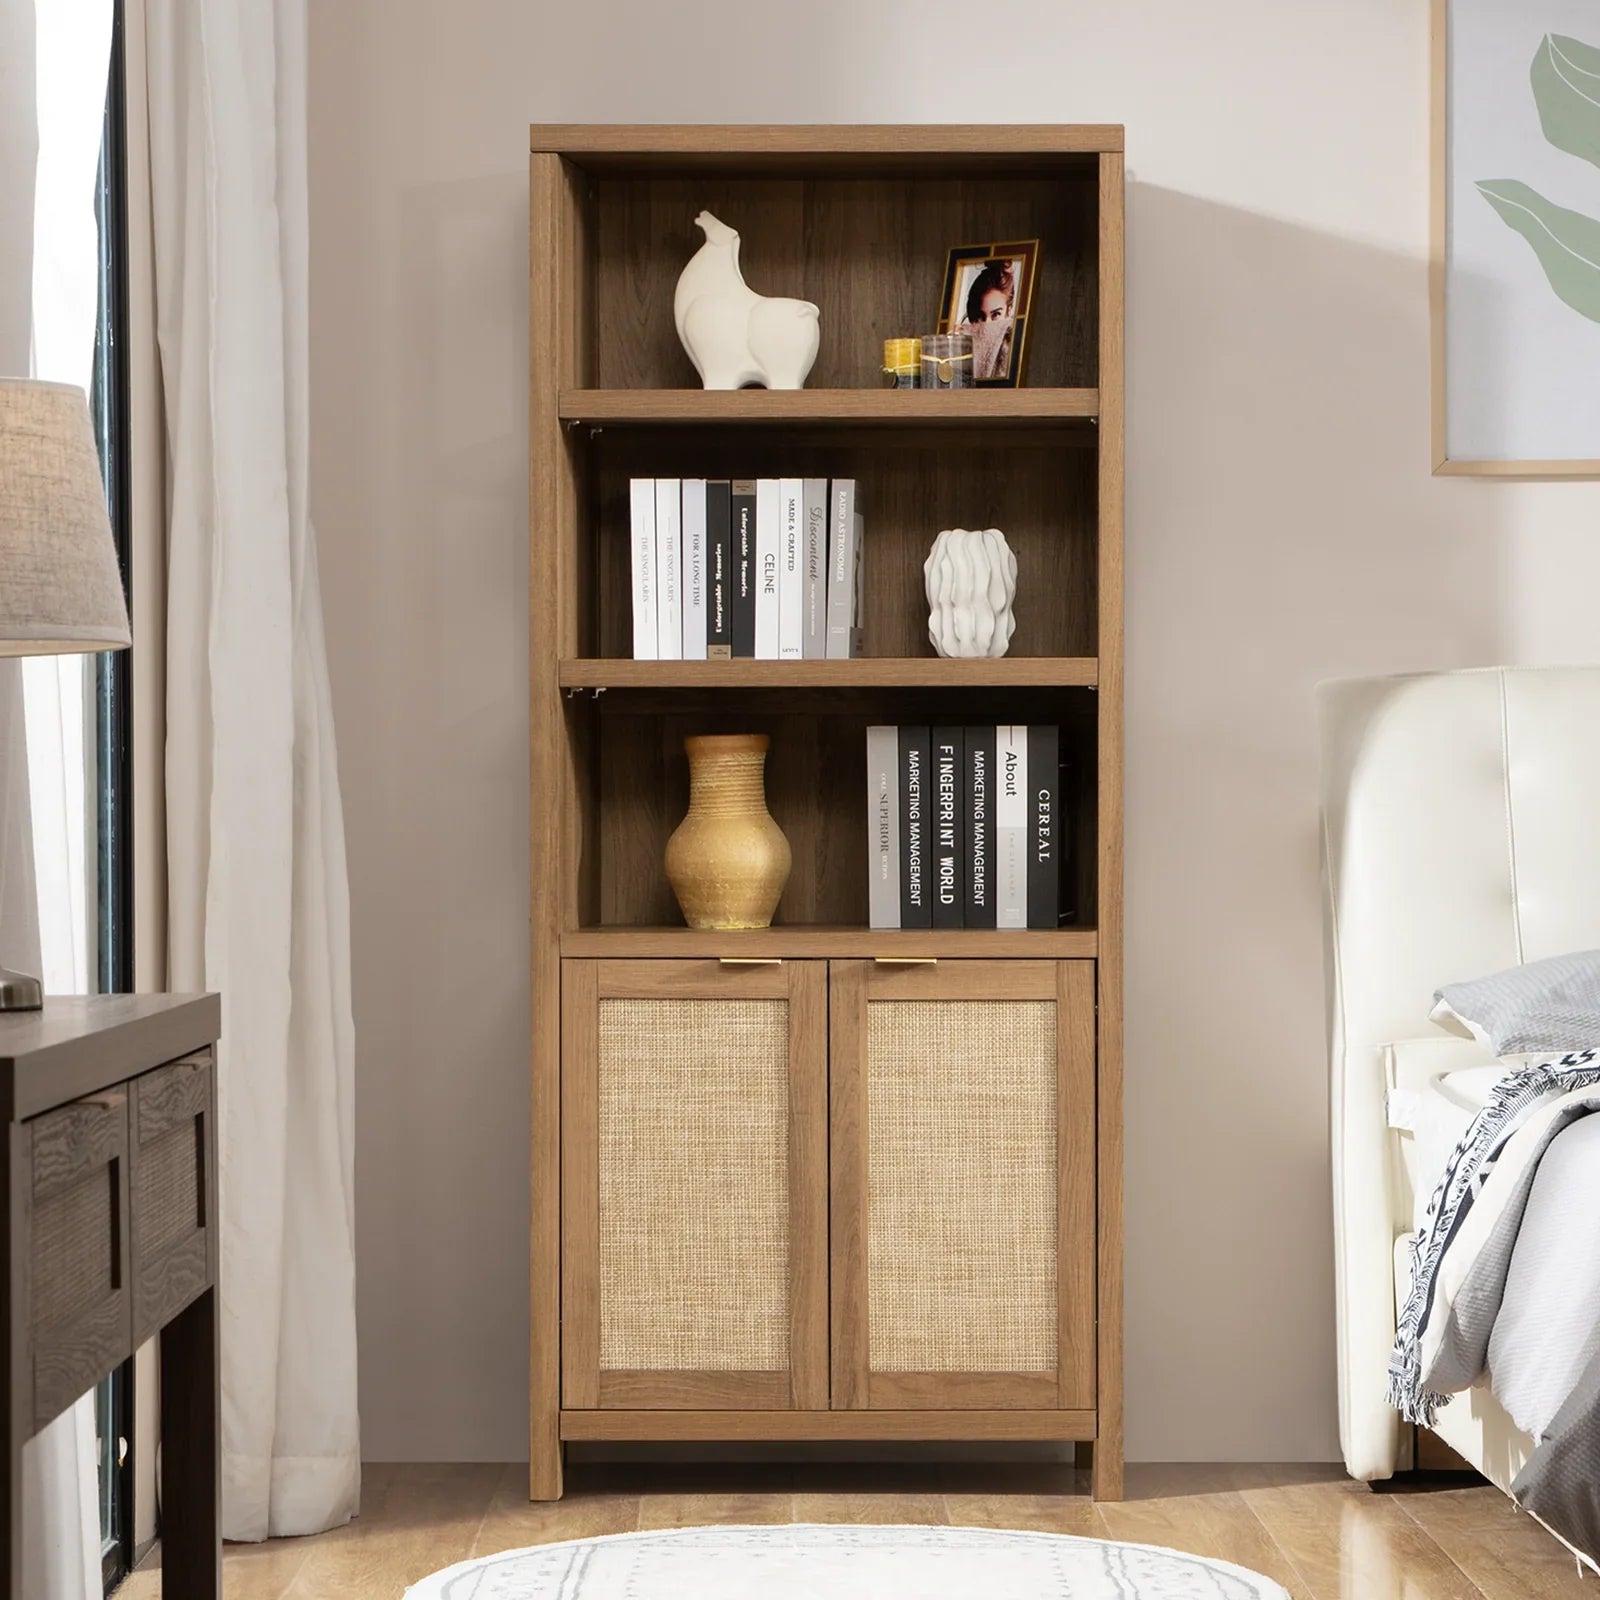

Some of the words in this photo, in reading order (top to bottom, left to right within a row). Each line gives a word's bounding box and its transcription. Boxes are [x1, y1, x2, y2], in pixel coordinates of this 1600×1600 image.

[839, 491, 847, 519] RADIO
[764, 553, 775, 594] CELINE
[809, 506, 823, 580] Discontent
[836, 521, 846, 583] ASTRONOMER
[909, 750, 920, 819] MARKETING
[939, 745, 953, 848] FINGERPRINT
[974, 750, 985, 819] MARKETING
[1005, 751, 1017, 796] About
[879, 793, 889, 852] SUPERIOR
[1038, 789, 1050, 863] CEREAL
[910, 821, 921, 906] MANAGEMENT
[940, 856, 954, 904] WORLD
[974, 821, 985, 906] MANAGEMENT
